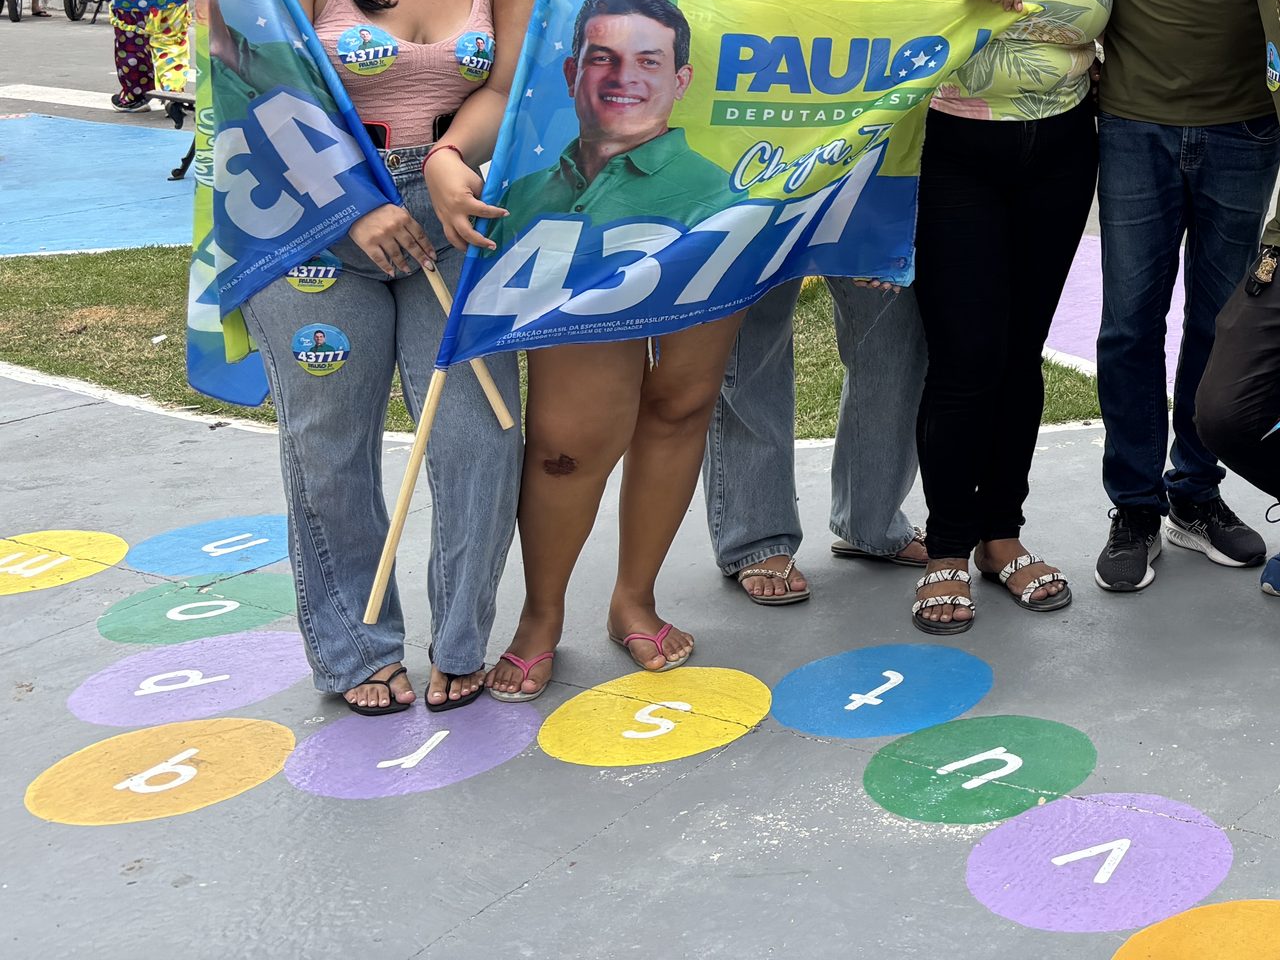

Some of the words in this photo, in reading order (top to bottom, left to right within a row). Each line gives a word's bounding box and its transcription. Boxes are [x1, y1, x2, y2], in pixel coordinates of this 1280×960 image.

[345, 45, 394, 63] 43777
[715, 32, 951, 95] PAULO
[725, 106, 865, 122] DEPUTADO
[288, 265, 336, 278] 43777
[298, 351, 344, 362] 43777
